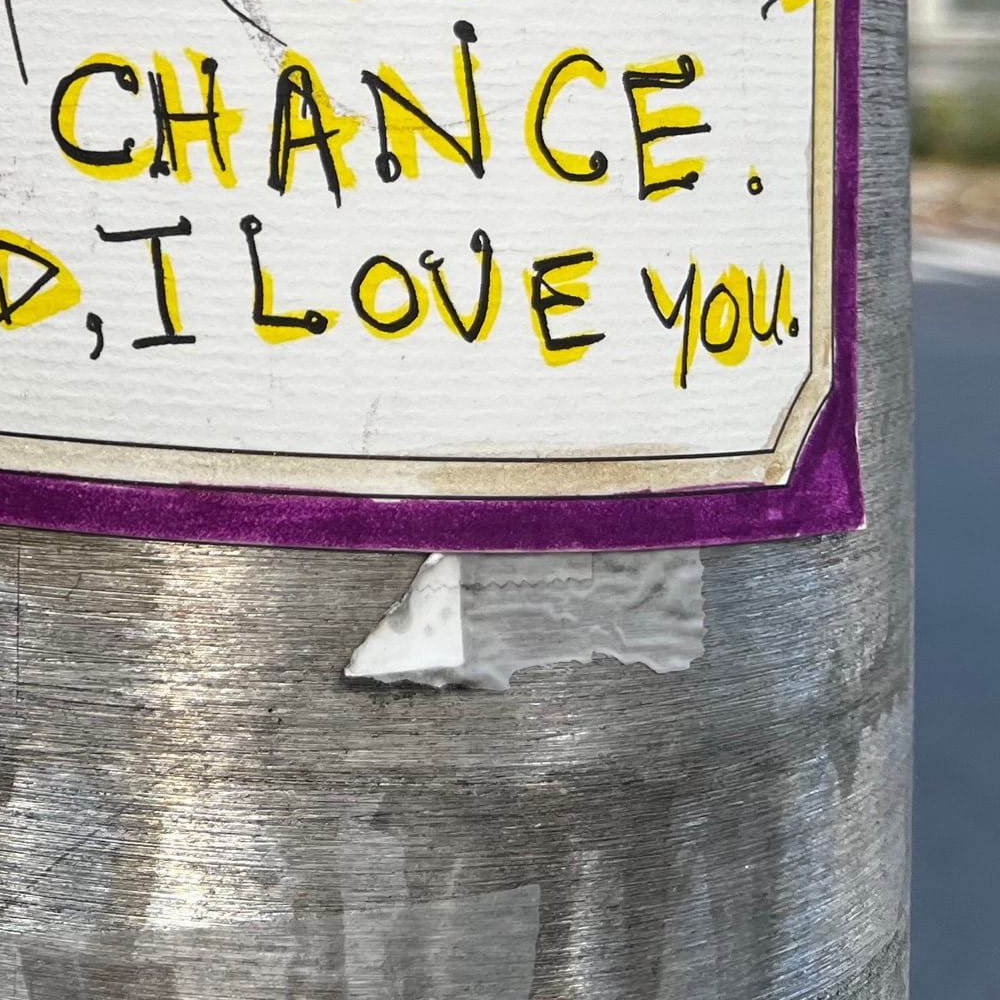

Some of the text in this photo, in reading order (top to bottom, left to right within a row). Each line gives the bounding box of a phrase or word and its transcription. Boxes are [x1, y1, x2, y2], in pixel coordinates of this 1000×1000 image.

[51, 21, 764, 208] CHANCE.
[97, 216, 196, 348] I
[241, 215, 605, 350] LOVE
[641, 263, 800, 389] YOU.
